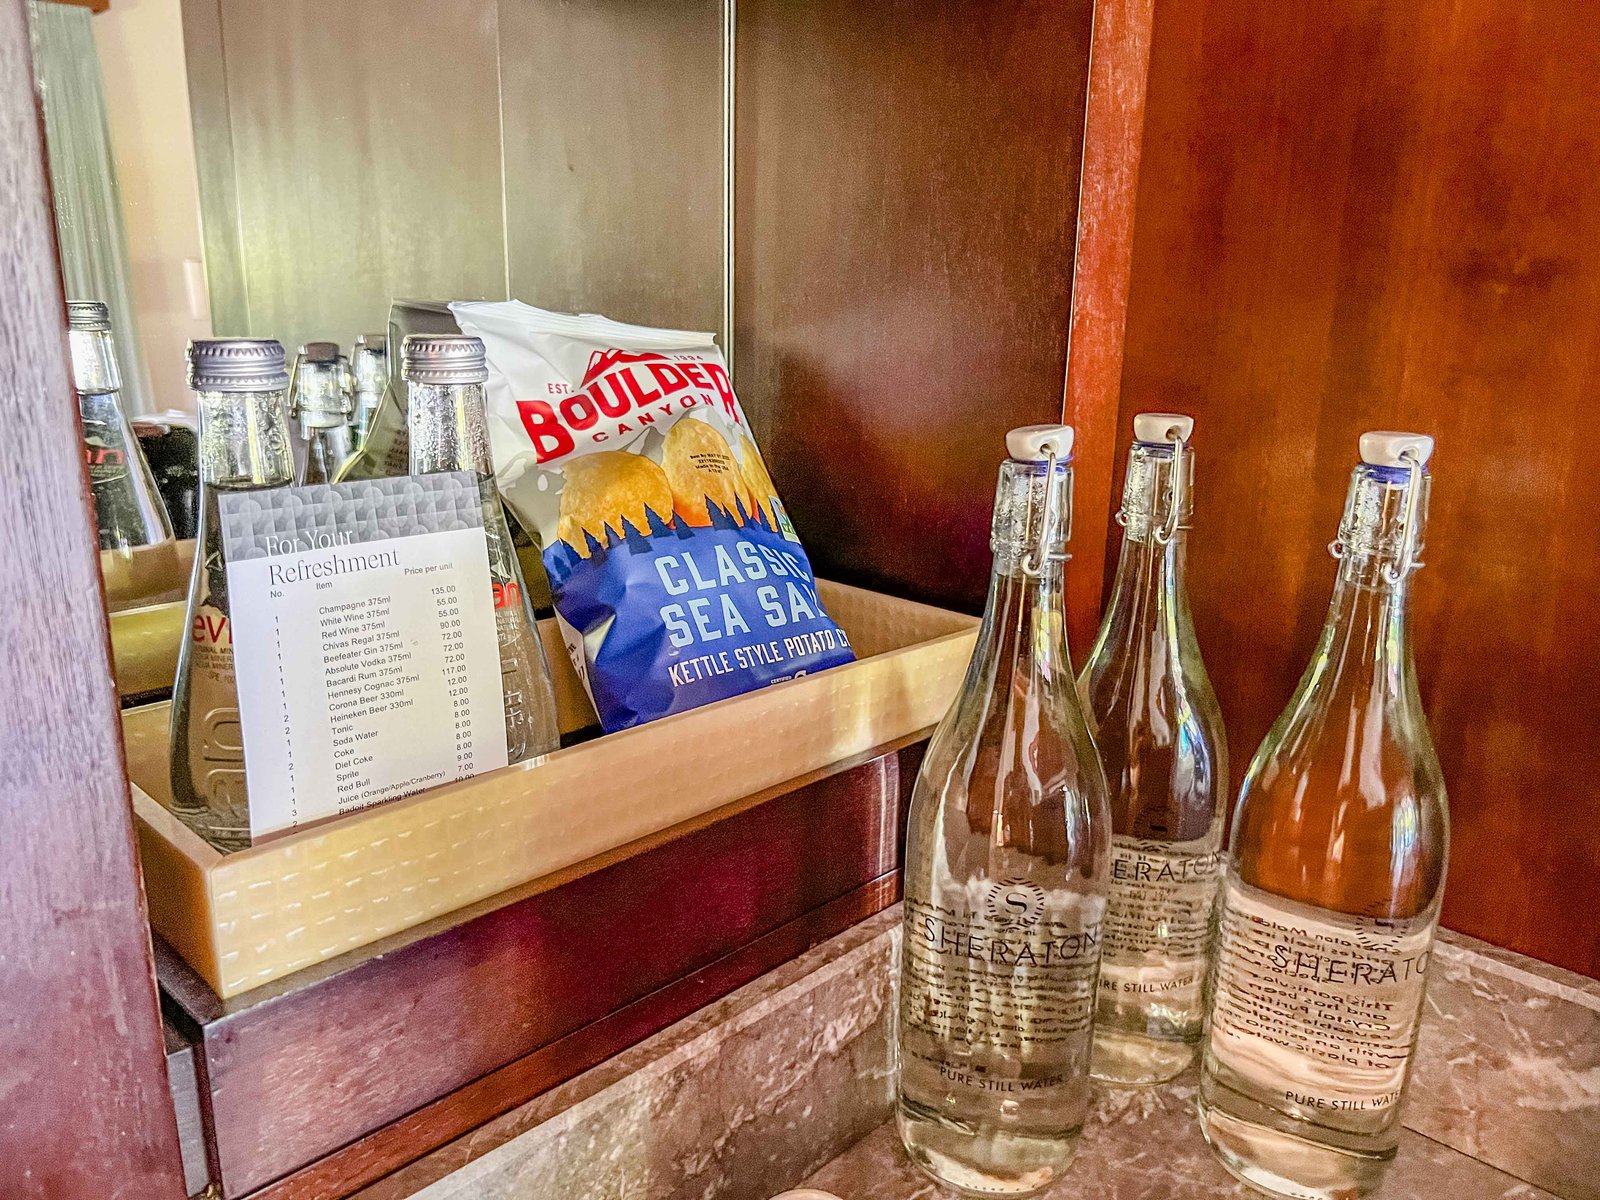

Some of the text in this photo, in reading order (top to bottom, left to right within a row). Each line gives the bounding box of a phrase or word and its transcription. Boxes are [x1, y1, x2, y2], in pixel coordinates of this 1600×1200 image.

[547, 383, 575, 395] EST.
[516, 362, 742, 465] BOULDER
[592, 393, 715, 443] CANYON
[265, 530, 352, 557] For Your
[268, 548, 400, 586] Refreshment
[270, 562, 453, 598] No. Item Price per unit
[654, 541, 811, 596] CLASSIC
[319, 601, 366, 615] Champagne
[368, 596, 390, 606] 375ml
[432, 585, 456, 594] 135.00
[320, 618, 342, 627] White
[344, 612, 364, 622] Wine
[366, 608, 390, 618] 375ml
[436, 596, 458, 606] 55.00
[322, 630, 338, 640] Red
[339, 625, 360, 636] Wine
[362, 621, 386, 632] 375ml
[438, 608, 458, 618] 55.00
[322, 642, 350, 652] Chivas
[351, 635, 374, 646] Regal
[376, 630, 400, 641] 375ml
[440, 620, 460, 630] 90.00
[660, 594, 751, 649] SEA
[324, 650, 362, 664] Beefeater
[364, 647, 378, 656] Gin
[380, 641, 404, 652] 375ml
[442, 630, 462, 640] 72.00
[325, 664, 359, 676] Absolute
[360, 657, 386, 668] Vodka
[388, 652, 412, 663] 375ml
[443, 642, 464, 652] 72.00
[668, 652, 734, 688] KETTLE
[734, 641, 784, 669] STYLE
[784, 630, 835, 659] POTATO
[326, 676, 356, 688] Bacardi
[358, 671, 377, 681] Rum
[379, 666, 402, 677] 375ml
[445, 654, 464, 664] 72.00
[328, 687, 362, 700] Hennesy
[364, 680, 394, 691] Cognac
[396, 674, 420, 686] 375ml
[442, 664, 466, 676] 117.00
[329, 700, 358, 711] Corona
[360, 694, 378, 705] Beer
[380, 689, 404, 700] 330ml
[448, 676, 467, 686] 12.00
[330, 710, 368, 723] Heineken
[369, 704, 388, 714] Beer
[390, 698, 414, 710] 330ml
[449, 686, 468, 696] 12.00
[332, 724, 354, 735] Tonic
[454, 698, 470, 707] 8.00
[332, 736, 354, 746] Soda
[355, 730, 379, 741] Water
[454, 708, 470, 718] 8.00
[334, 748, 354, 758] Coke
[456, 720, 471, 729] 8.00
[335, 760, 352, 770] Diet
[353, 755, 374, 766] Coke
[456, 730, 472, 740] 8.00
[336, 770, 360, 782] Sprite
[456, 742, 472, 751] 8.00
[338, 783, 354, 793] Red
[356, 778, 371, 788] Bull
[457, 752, 472, 762] 9.00
[338, 794, 360, 804] Juice
[458, 762, 474, 772] 7.00
[924, 918, 1100, 968] SHERATON
[1272, 944, 1429, 984] SHERATO
[1124, 983, 1154, 992] STILL
[1160, 976, 1193, 991] WATER
[940, 1066, 1063, 1092] PURE STILL WATER
[1286, 1090, 1327, 1109] PURE
[1332, 1100, 1366, 1111] STILL
